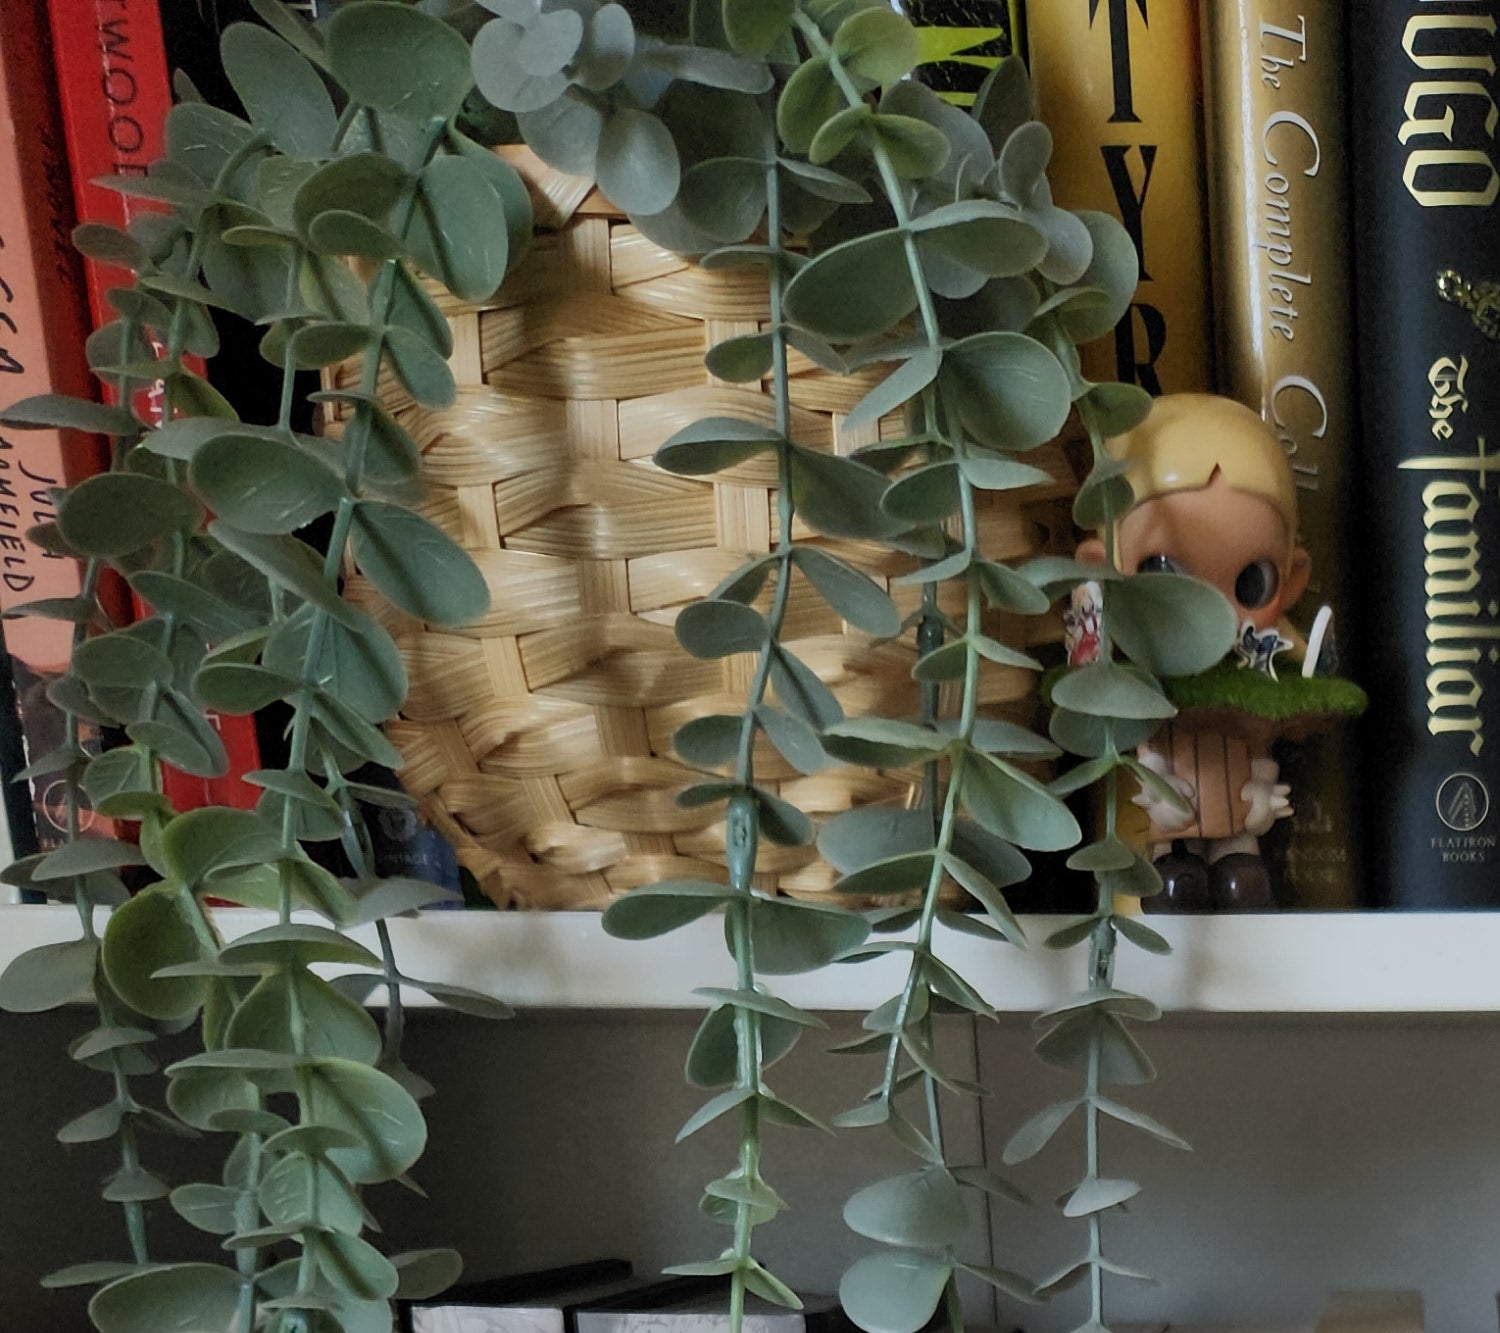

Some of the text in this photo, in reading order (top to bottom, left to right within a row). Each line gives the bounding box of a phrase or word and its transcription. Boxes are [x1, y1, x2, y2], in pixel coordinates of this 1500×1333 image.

[96, 0, 148, 177] WOO
[1258, 14, 1307, 90] The
[1397, 0, 1500, 208] UGO
[1252, 110, 1320, 342] Complete
[1426, 355, 1469, 441] The
[1430, 836, 1497, 851] FLATIRON
[1441, 851, 1487, 865] BOOKS
